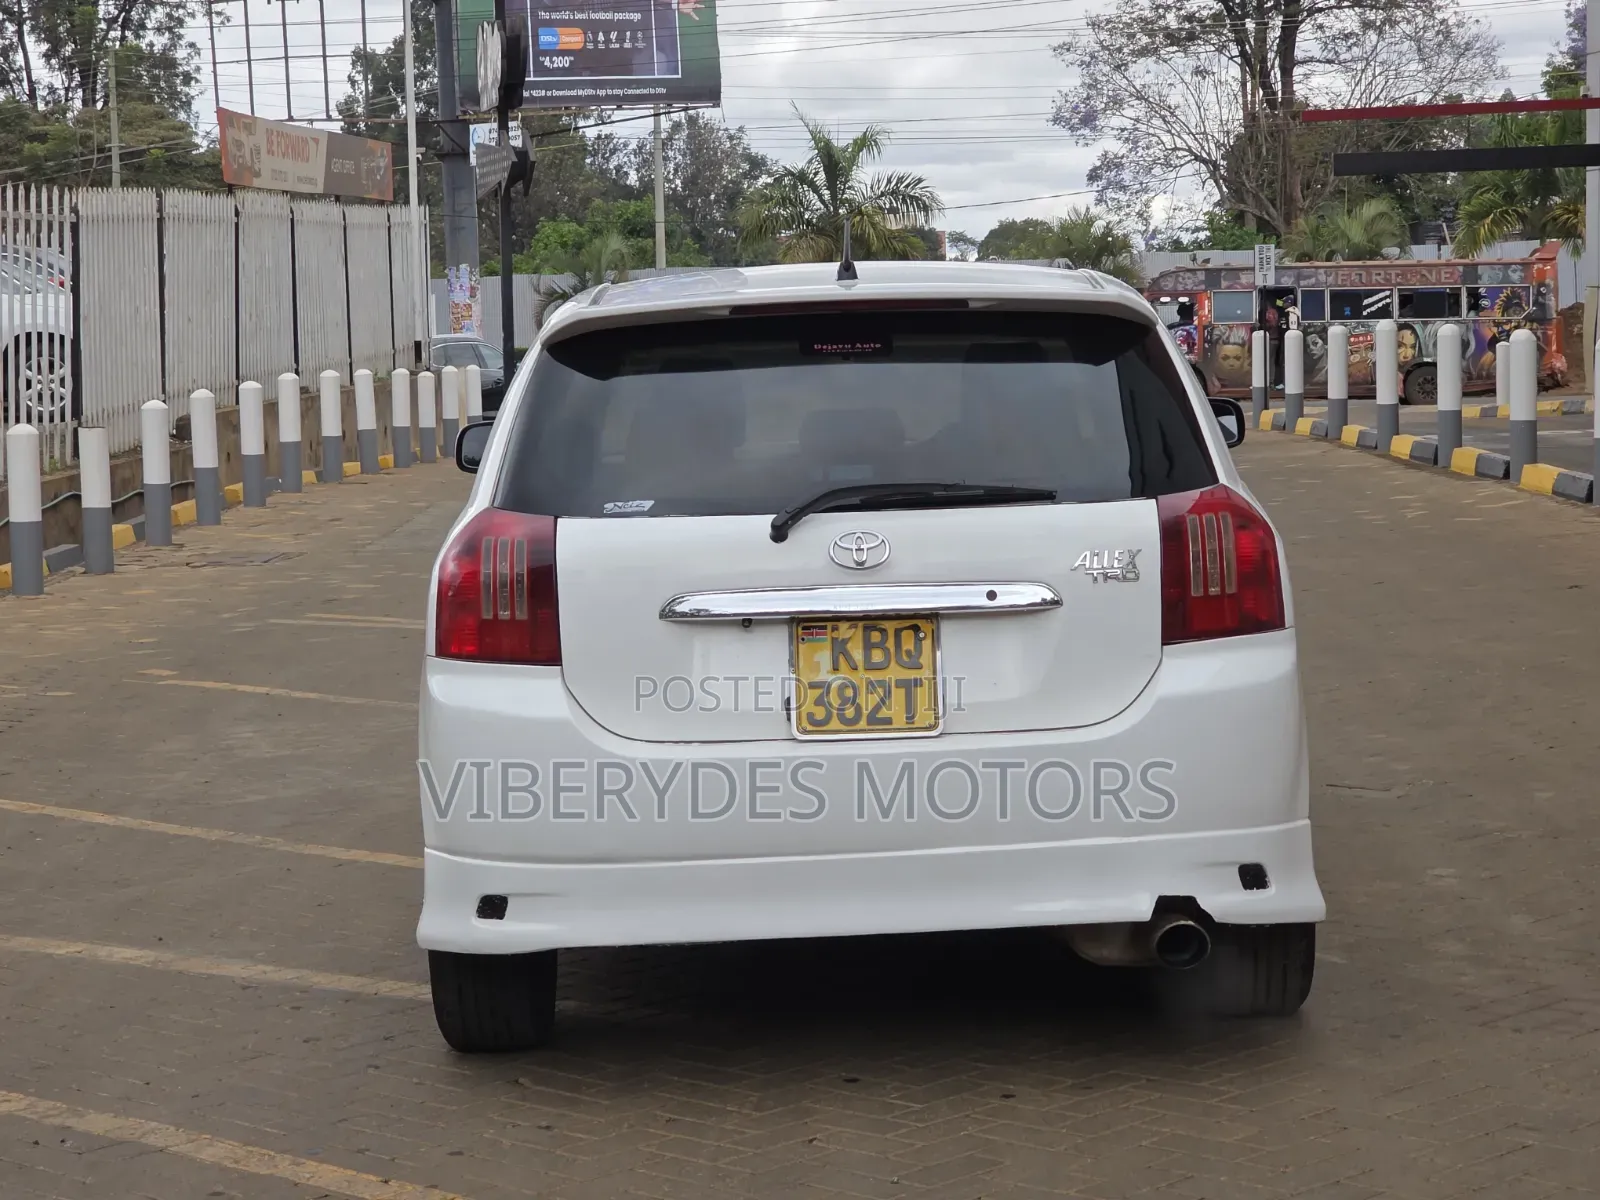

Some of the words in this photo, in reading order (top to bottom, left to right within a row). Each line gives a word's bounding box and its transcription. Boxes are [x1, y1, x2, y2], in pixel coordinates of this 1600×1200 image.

[538, 11, 550, 19] The
[551, 11, 573, 19] world's
[574, 11, 588, 19] best
[589, 10, 613, 19] football
[614, 12, 642, 22] package
[544, 56, 570, 69] 4,200
[552, 89, 578, 97] Download
[596, 89, 606, 97] App
[612, 89, 623, 97] stay
[266, 127, 275, 157] BE
[276, 130, 310, 163] FORWARD
[831, 623, 923, 671] KBQ
[806, 678, 924, 728] 382T
